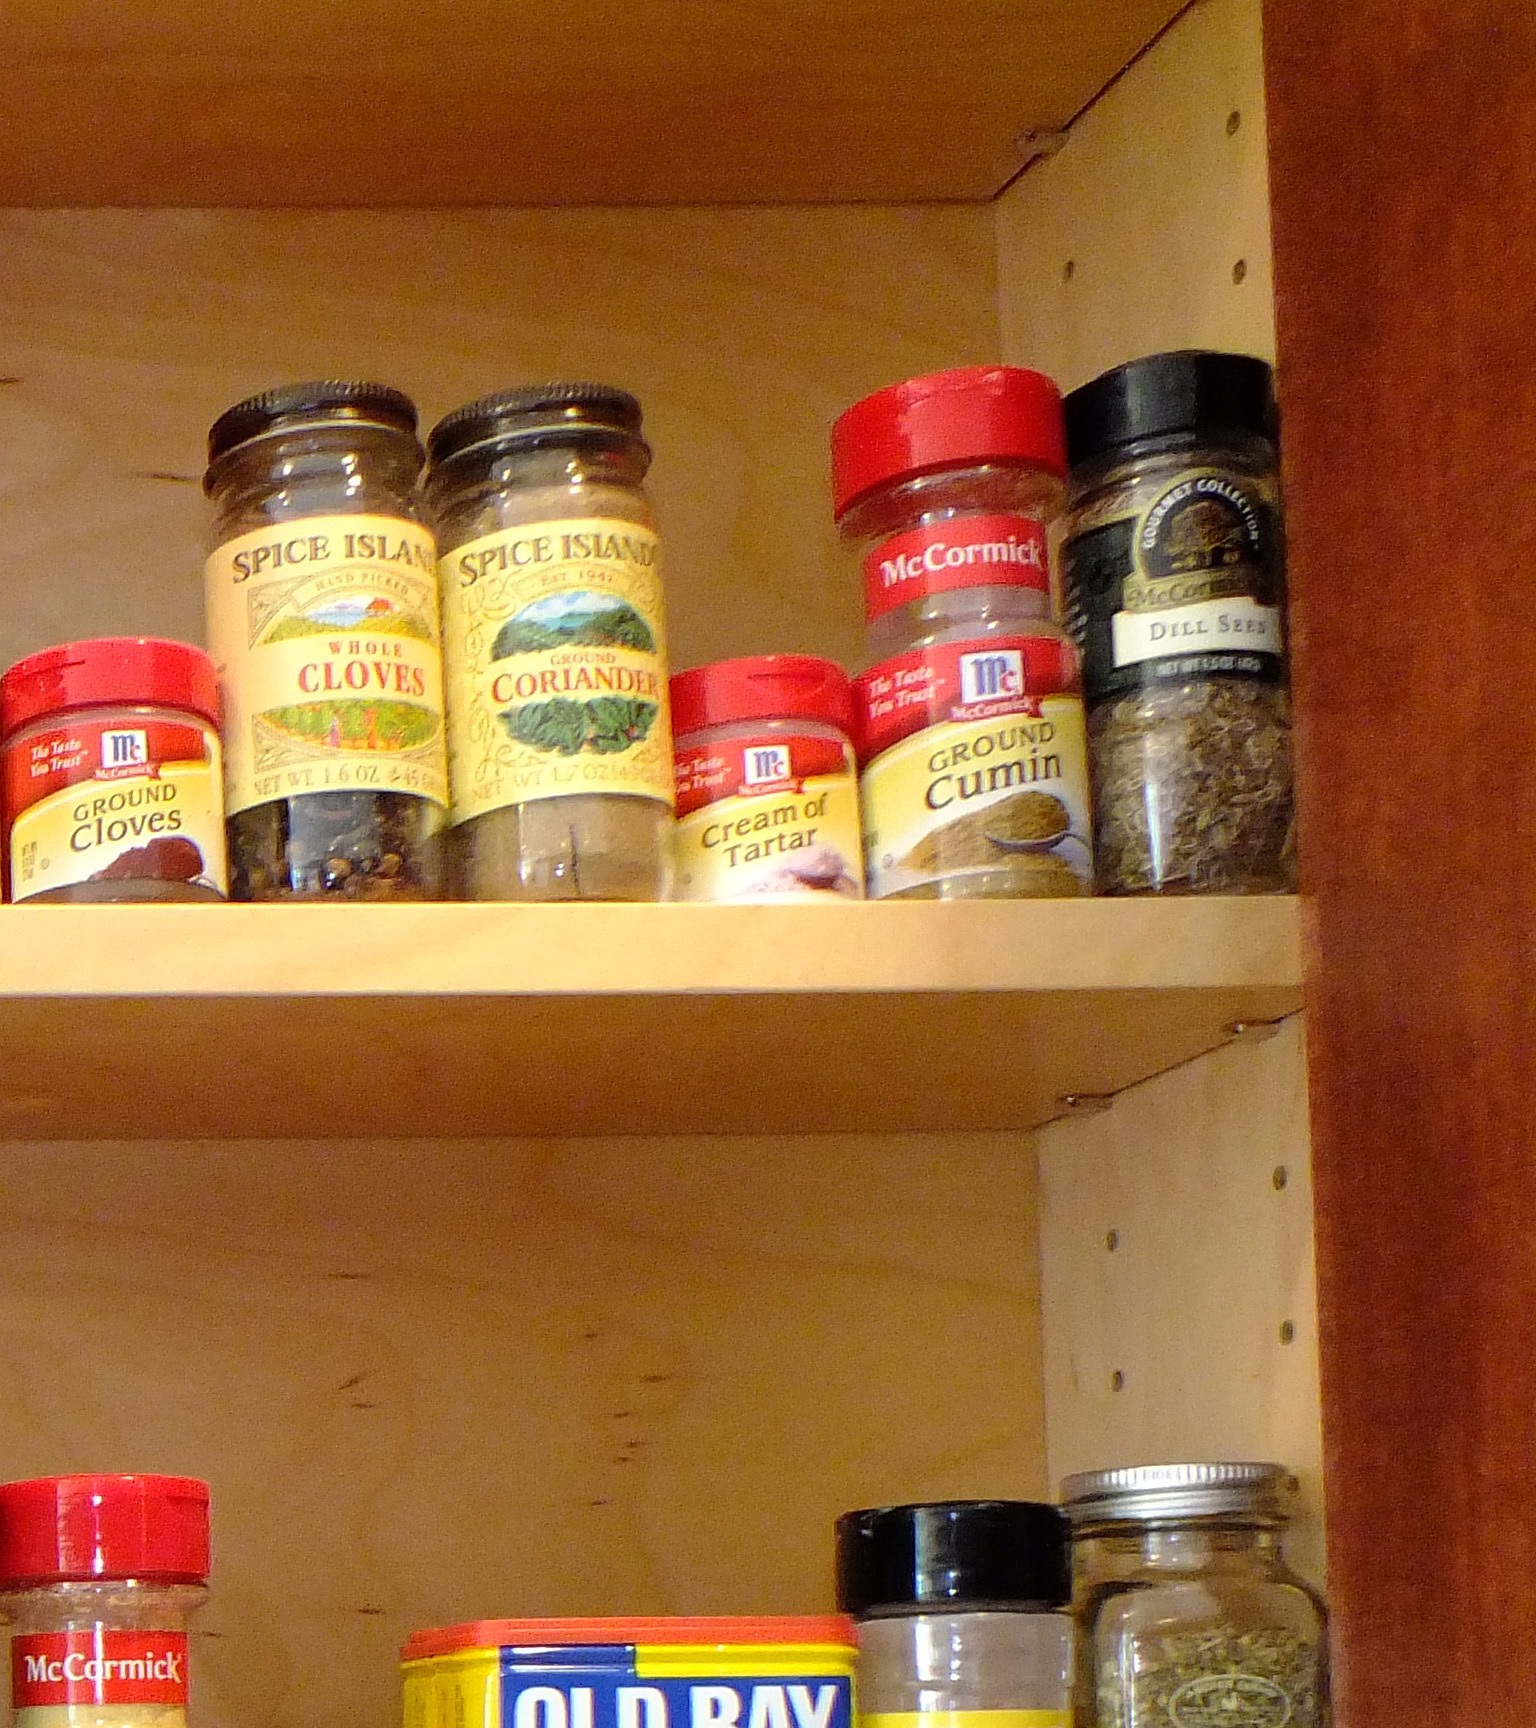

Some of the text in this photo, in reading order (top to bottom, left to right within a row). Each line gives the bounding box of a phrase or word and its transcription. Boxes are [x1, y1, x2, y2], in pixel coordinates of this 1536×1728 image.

[232, 535, 331, 585] SPICE
[458, 535, 554, 588] SPICE
[880, 536, 1047, 588] McCormick
[328, 640, 403, 659] WHOLE
[549, 651, 618, 665] GROUND
[298, 660, 426, 697] CLOVES
[491, 667, 660, 704] CORIANDER
[927, 721, 1056, 773] GROUND
[925, 748, 1062, 811] Cumin
[73, 783, 178, 822] GROUND
[702, 792, 828, 850] Cream of
[69, 809, 183, 853] Cloves
[721, 827, 820, 869] Tartar
[24, 1650, 182, 1685] McCormick
